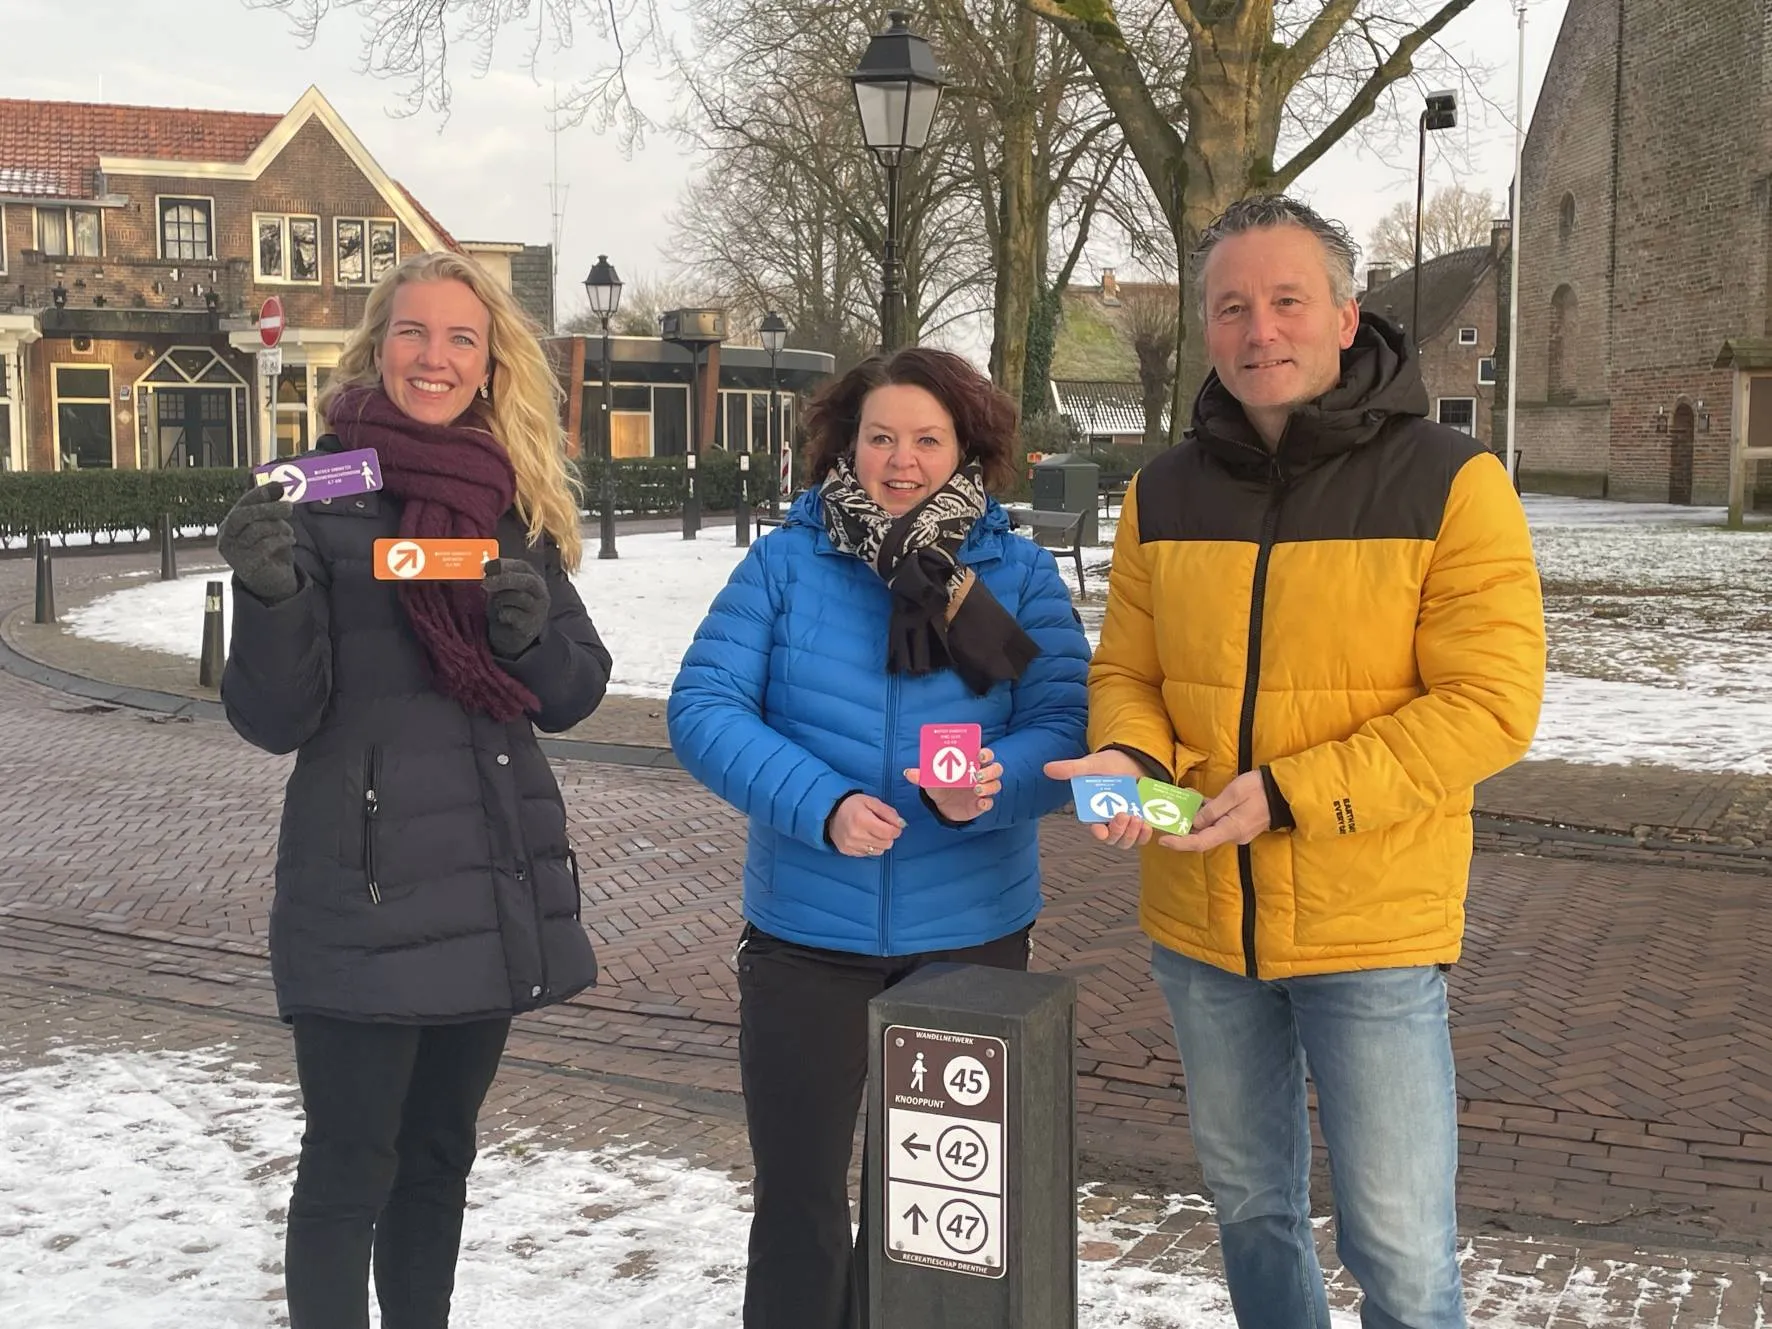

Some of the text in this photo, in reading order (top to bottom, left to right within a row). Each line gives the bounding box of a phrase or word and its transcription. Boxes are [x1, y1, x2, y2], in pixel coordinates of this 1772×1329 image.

[915, 1031, 974, 1045] WANDELNETWERK
[949, 1068, 984, 1094] 45
[895, 1094, 945, 1109] KNOOPPUNT
[945, 1140, 979, 1168] 42
[946, 1214, 980, 1240] 47
[902, 1252, 988, 1274] RECREATIESCHAP DRENTHE
